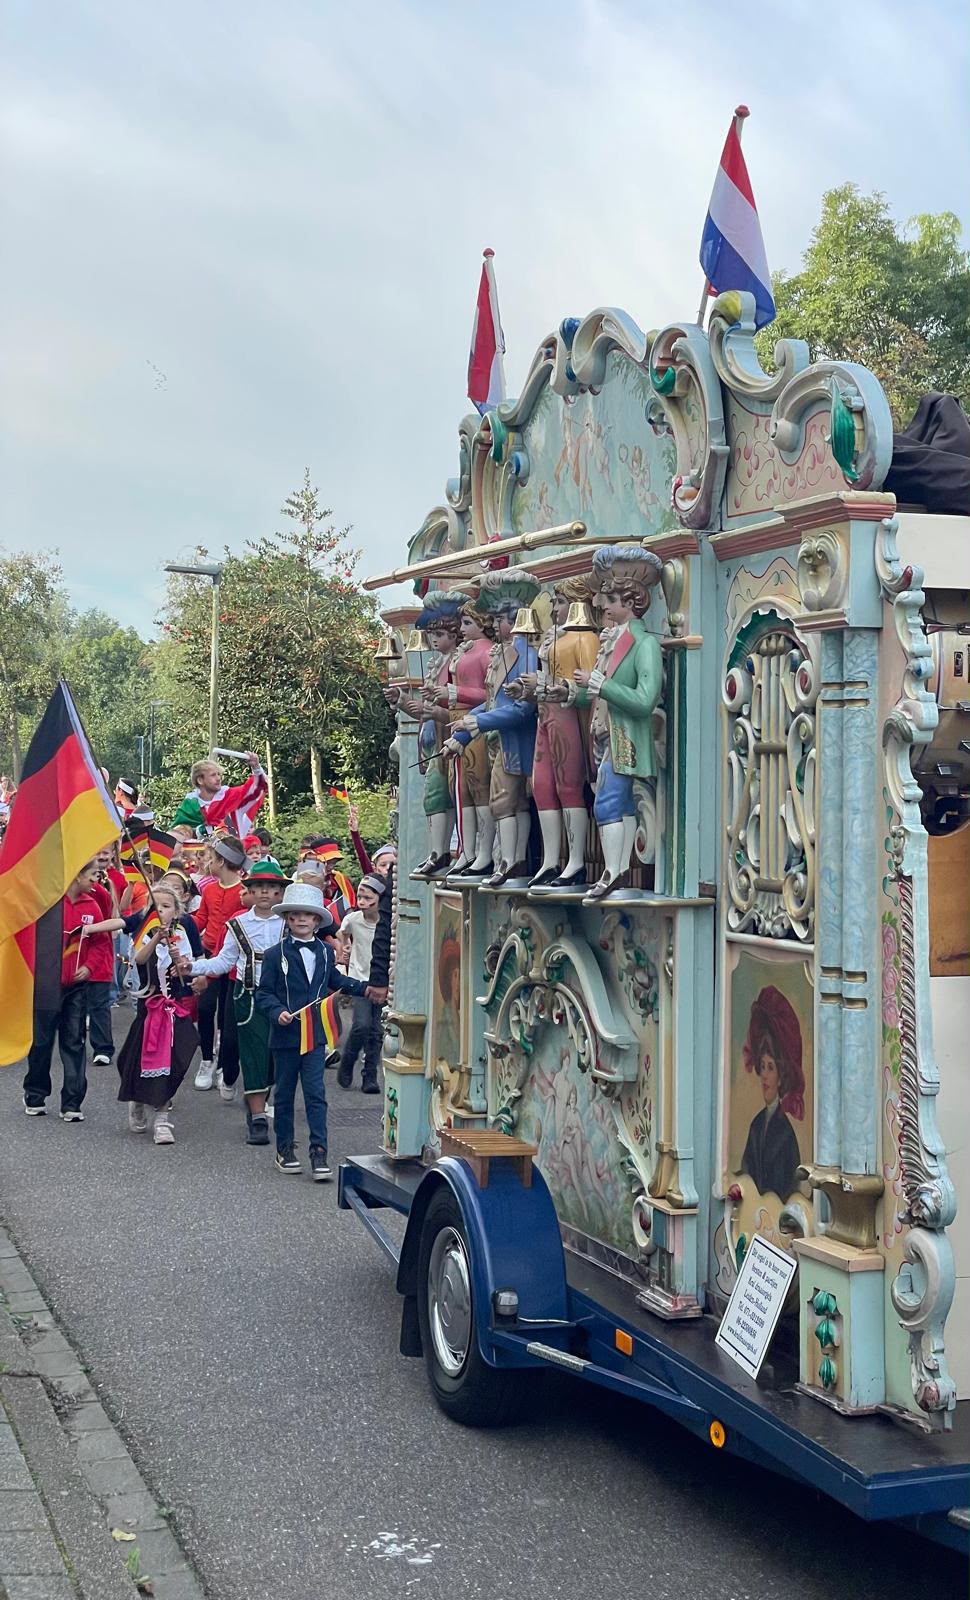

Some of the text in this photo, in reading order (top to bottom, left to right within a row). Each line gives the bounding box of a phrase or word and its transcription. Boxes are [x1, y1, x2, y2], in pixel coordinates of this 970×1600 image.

[752, 1263, 762, 1277] feesten
[765, 1275, 778, 1289] partijen
[757, 1253, 766, 1263] orgel
[772, 1263, 780, 1274] huur
[779, 1270, 788, 1279] voor
